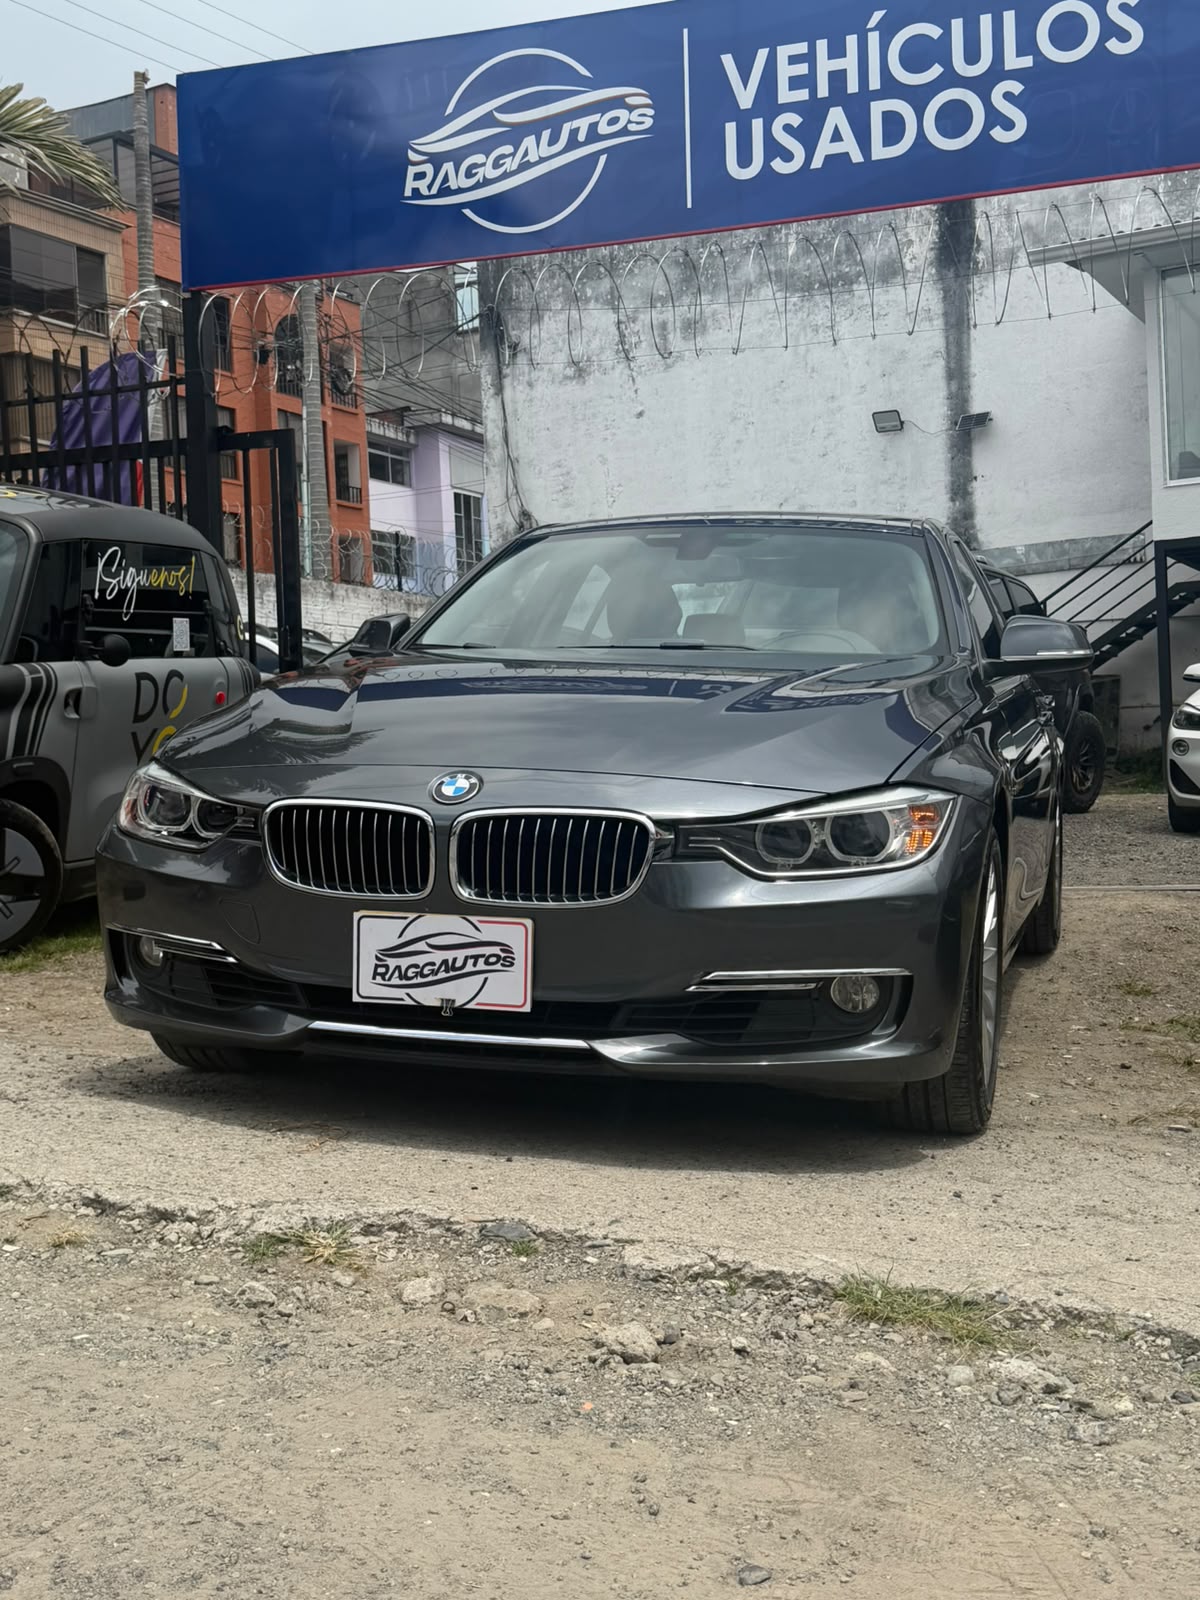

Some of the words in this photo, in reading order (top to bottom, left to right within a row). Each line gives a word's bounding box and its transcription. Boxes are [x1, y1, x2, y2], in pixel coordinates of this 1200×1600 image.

[720, 0, 1144, 111] VEHÍCULOS
[403, 107, 655, 197] RAGGAUTOS
[724, 79, 1028, 181] USADOS
[132, 668, 188, 724] DO
[371, 952, 516, 983] RAGGAUTOS
